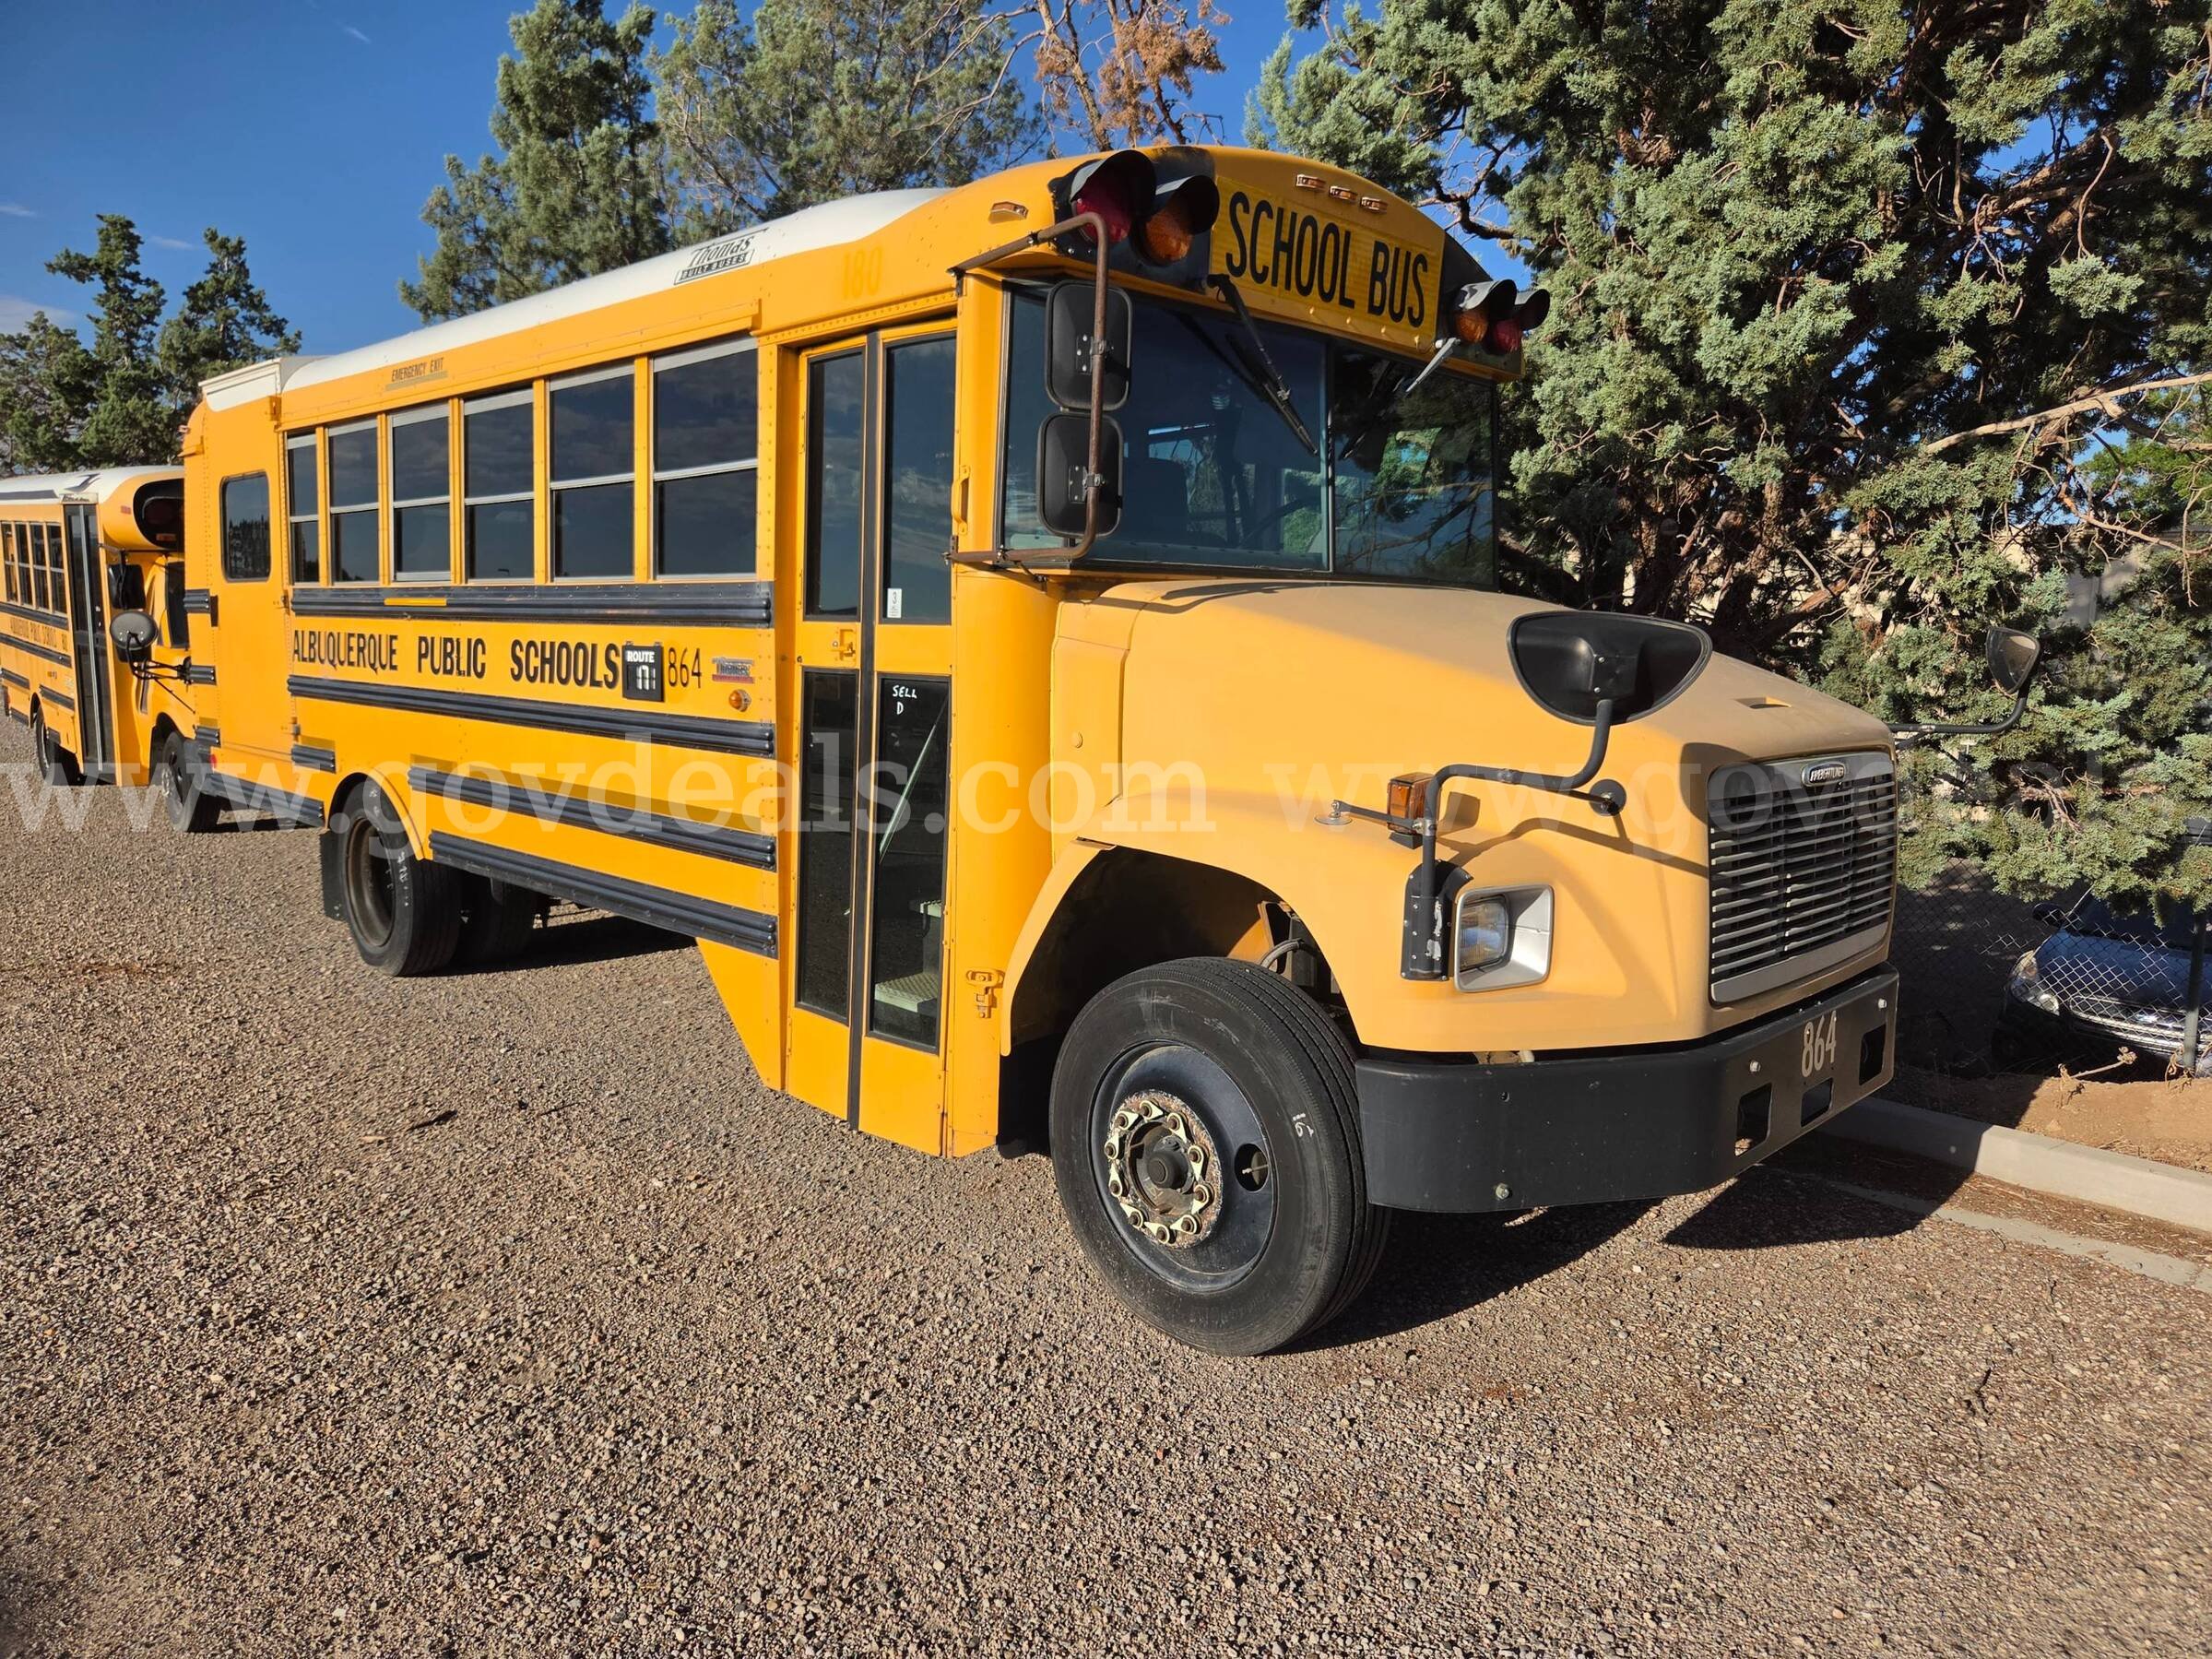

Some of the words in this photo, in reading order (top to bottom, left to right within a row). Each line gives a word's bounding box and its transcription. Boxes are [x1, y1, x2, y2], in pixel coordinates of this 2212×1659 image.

[687, 232, 756, 267] Thomas
[1224, 191, 1355, 309] SCHOOL
[1367, 240, 1428, 328] BUS
[679, 266, 709, 281] BUILT
[711, 252, 749, 271] BUSES
[391, 362, 428, 382] EMERGENCY
[430, 357, 444, 373] EXIT
[292, 630, 398, 675] ALBUQUERQUE
[418, 636, 486, 679] PUBLIC
[510, 639, 621, 689] SCHOOLS
[626, 650, 655, 663] ROUTE
[668, 647, 702, 689] 864
[892, 685, 917, 698] SELL
[896, 701, 905, 716] D
[1802, 1011, 1837, 1077] 864
